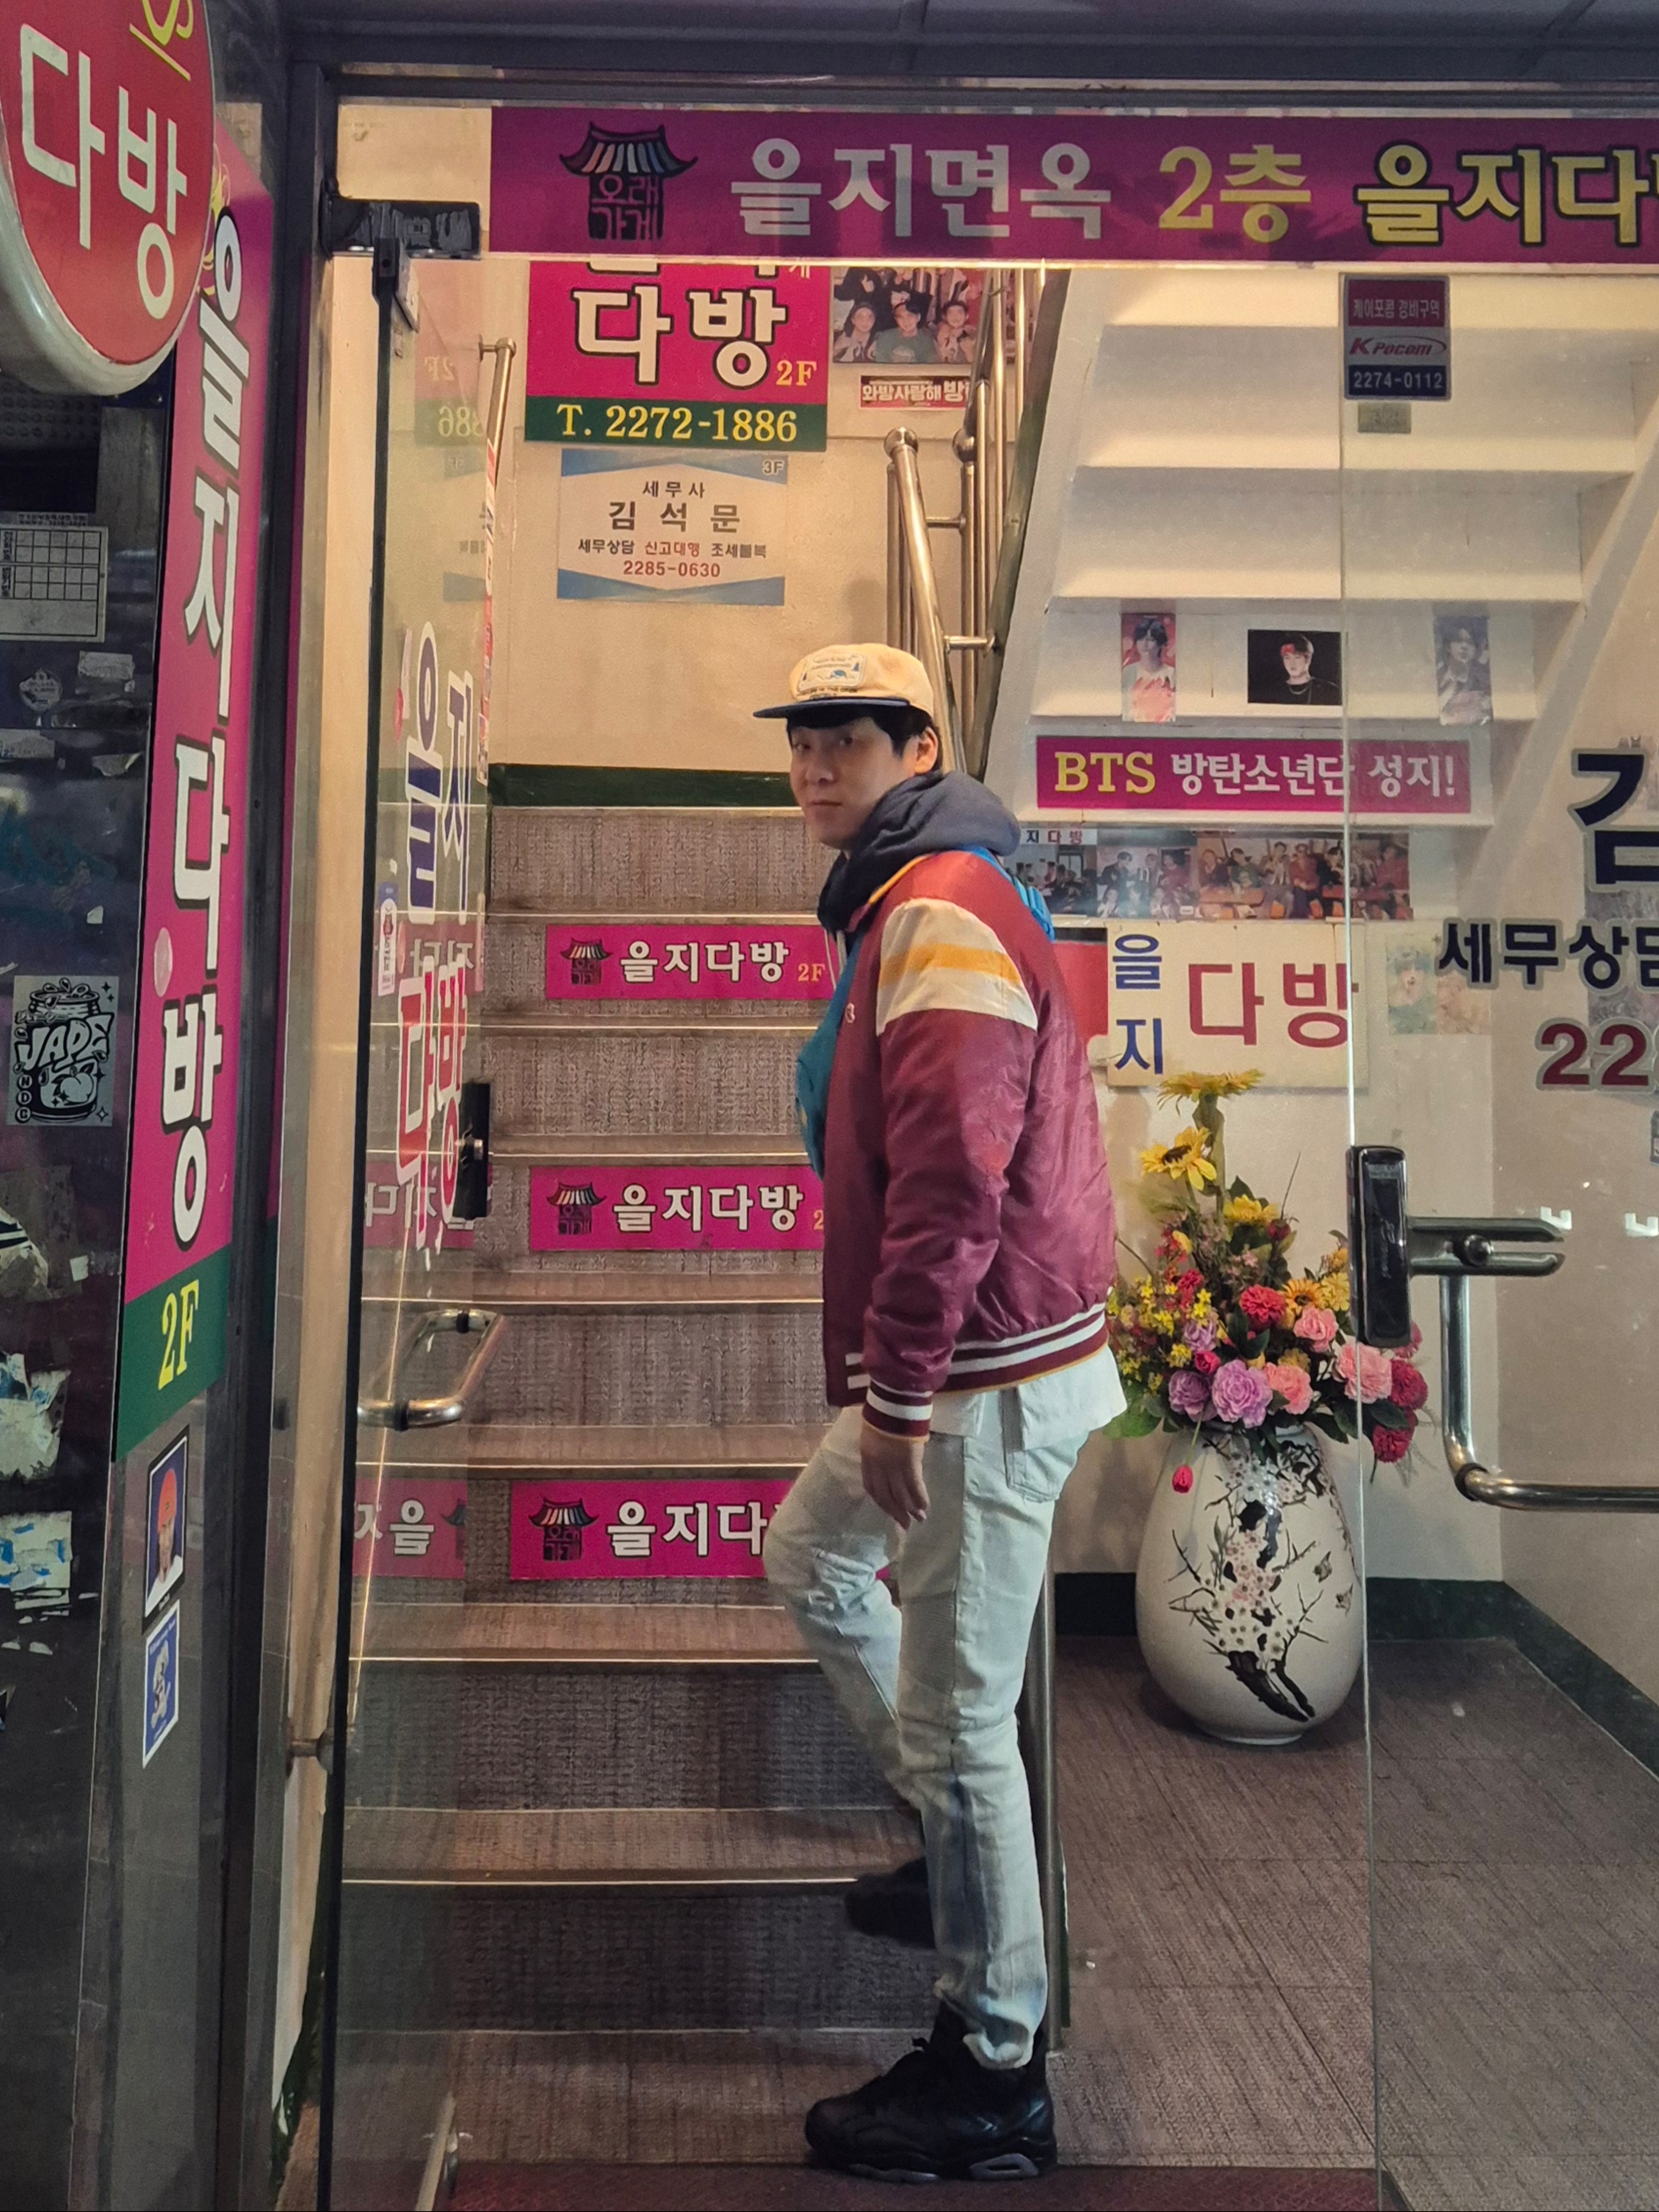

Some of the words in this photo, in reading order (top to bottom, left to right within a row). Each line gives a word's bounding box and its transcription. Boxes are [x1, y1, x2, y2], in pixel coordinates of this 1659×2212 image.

[19, 23, 187, 320] 다방
[730, 137, 1112, 241] 을지면옥
[1158, 144, 1312, 244] 2층
[1356, 143, 1659, 244] 을지다
[571, 284, 788, 388] 다방
[776, 359, 818, 387] 2F
[1353, 372, 1444, 388] 2274-0112
[556, 403, 592, 438] T.
[606, 405, 798, 441] 2272-1886
[762, 460, 785, 474] 3F
[577, 538, 636, 555] 세무상담
[644, 541, 701, 558] 신고대행
[623, 560, 721, 578] 2285-0630
[163, 207, 253, 1246] 을지다방
[1054, 751, 1156, 794] BTS
[1171, 753, 1355, 797] 방탄소년단
[1368, 755, 1455, 797] 성지!
[620, 940, 789, 983] 을지다방
[798, 962, 826, 982] 2F
[1188, 961, 1360, 1049] 다방
[612, 1183, 805, 1232] 을지다방
[813, 1209, 824, 1230] 2
[158, 1277, 200, 1391] 2F
[606, 1500, 784, 1558] 을지다
